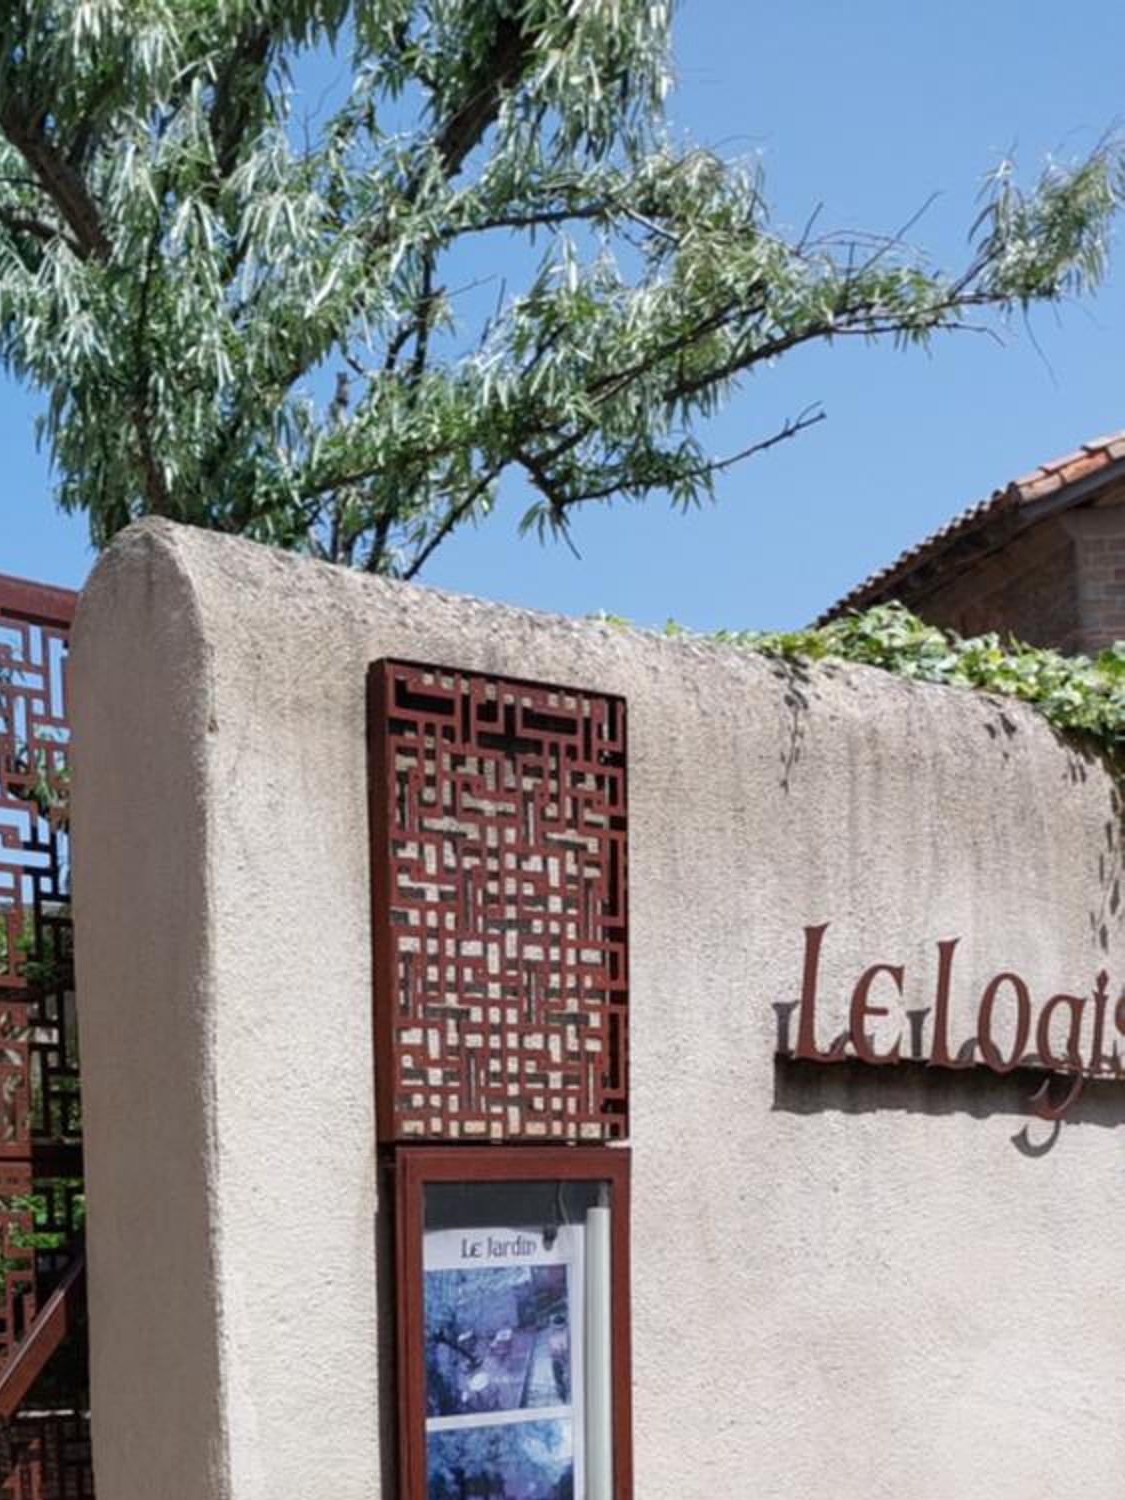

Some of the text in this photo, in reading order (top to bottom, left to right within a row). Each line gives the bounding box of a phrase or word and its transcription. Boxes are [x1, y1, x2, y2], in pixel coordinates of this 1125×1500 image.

[793, 922, 904, 1065] Le
[461, 1235, 537, 1258] Le Jardin
